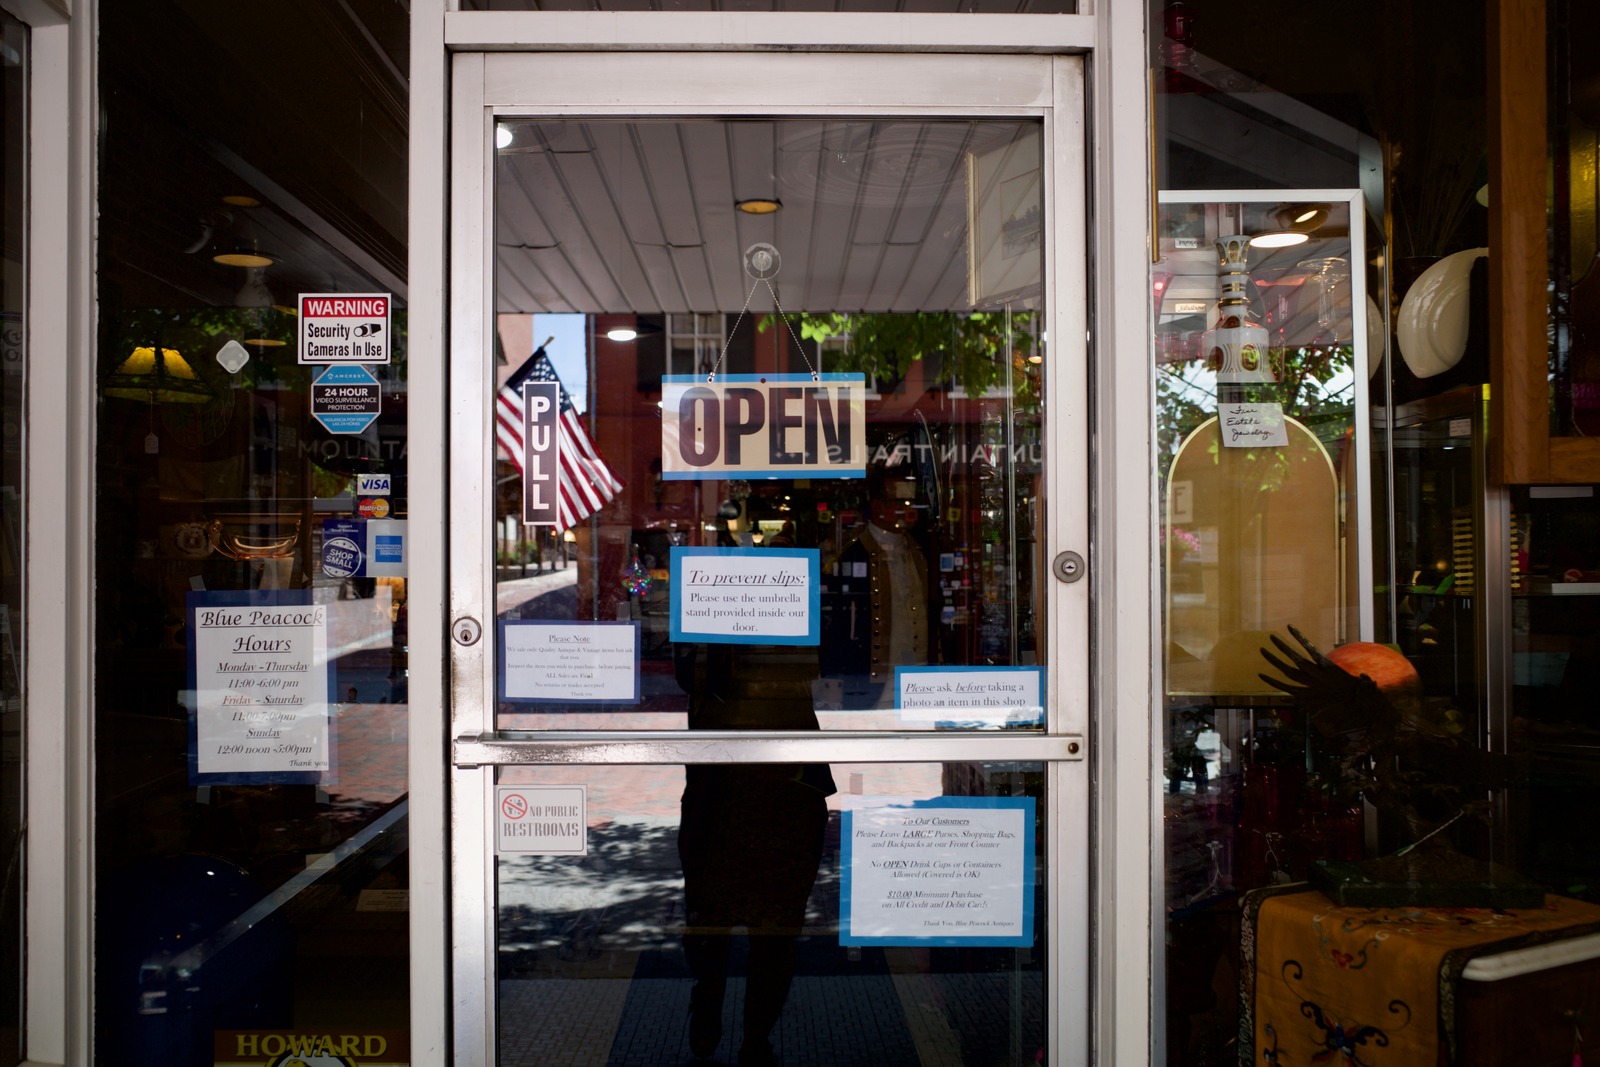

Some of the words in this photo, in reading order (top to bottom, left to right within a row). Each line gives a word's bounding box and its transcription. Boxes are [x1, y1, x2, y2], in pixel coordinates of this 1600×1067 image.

[308, 300, 384, 316] WARNING
[308, 323, 350, 340] Security
[308, 342, 349, 356] Cameras
[352, 342, 362, 356] In
[365, 342, 382, 356] Use
[324, 388, 338, 396] 24
[340, 388, 368, 396] HOUR
[679, 386, 850, 466] OPEN
[1226, 417, 1260, 426] Estate
[531, 396, 550, 510] PULL
[361, 479, 389, 490] VISA
[330, 548, 354, 560] SHOP
[326, 555, 353, 569] SMALL
[690, 570, 710, 584] To
[712, 573, 767, 587] prevent
[770, 570, 806, 587] slips:
[690, 593, 720, 602] Please
[741, 593, 756, 602] the
[759, 593, 800, 603] umbrella
[201, 609, 242, 626] Blue
[249, 608, 323, 626] Peacock
[686, 608, 710, 617] stand
[713, 608, 755, 618] provided
[758, 608, 786, 617] inside
[732, 622, 758, 632] door.
[232, 635, 292, 651] Hours
[217, 662, 256, 672] Monday
[228, 679, 255, 688] 11:00
[282, 681, 299, 689] pm
[905, 683, 935, 692] Please
[937, 683, 952, 692] ask
[955, 682, 986, 692] before
[988, 682, 1016, 692] taking
[222, 696, 252, 705] Friday
[263, 695, 305, 705] Saturday
[903, 698, 931, 709] photo
[948, 697, 968, 706] item
[971, 698, 980, 706] in
[984, 697, 1000, 706] this
[1002, 697, 1026, 707] shop
[232, 712, 296, 722] 11:00-7:00pm
[246, 728, 282, 738] Sunday
[217, 745, 243, 754] 12:00
[273, 744, 312, 755] -5:00pm
[530, 806, 542, 817] NO
[545, 806, 578, 817] PUBLIC
[504, 822, 579, 837] RESTROOMS
[961, 831, 995, 839] Shopping
[933, 861, 951, 869] Cups
[922, 870, 955, 878] (Covered
[887, 890, 912, 899] $10.00
[236, 1034, 387, 1057] HOWARD
